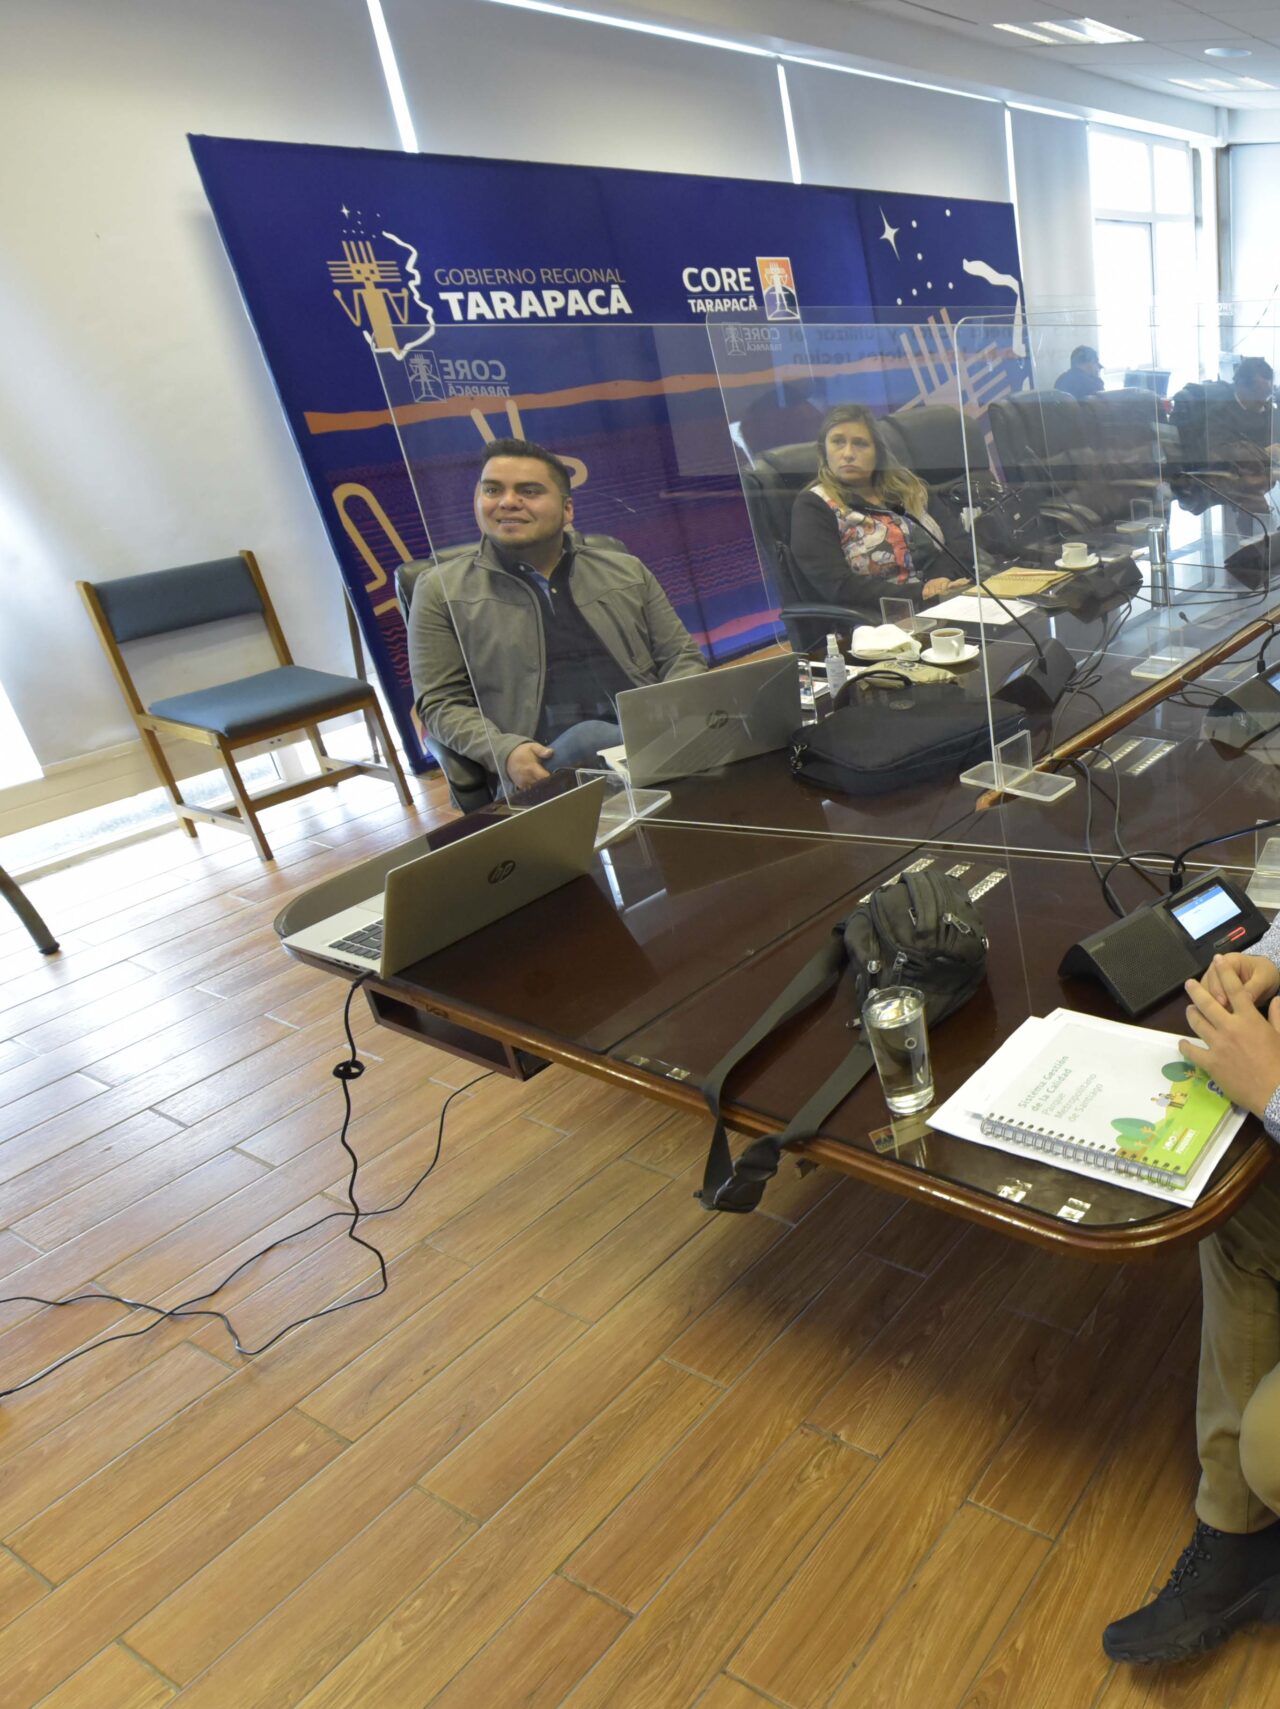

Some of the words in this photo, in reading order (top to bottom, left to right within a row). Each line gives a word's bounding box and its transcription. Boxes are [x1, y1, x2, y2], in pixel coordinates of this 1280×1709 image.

[434, 268, 536, 287] GOBIERNO
[540, 267, 626, 285] REGIONAL
[682, 267, 755, 293] CORE
[439, 284, 633, 321] TARAPACÁ
[687, 295, 758, 314] TARAPACÁ
[1017, 1080, 1048, 1109] Sistema
[1046, 1067, 1073, 1095] Calidad
